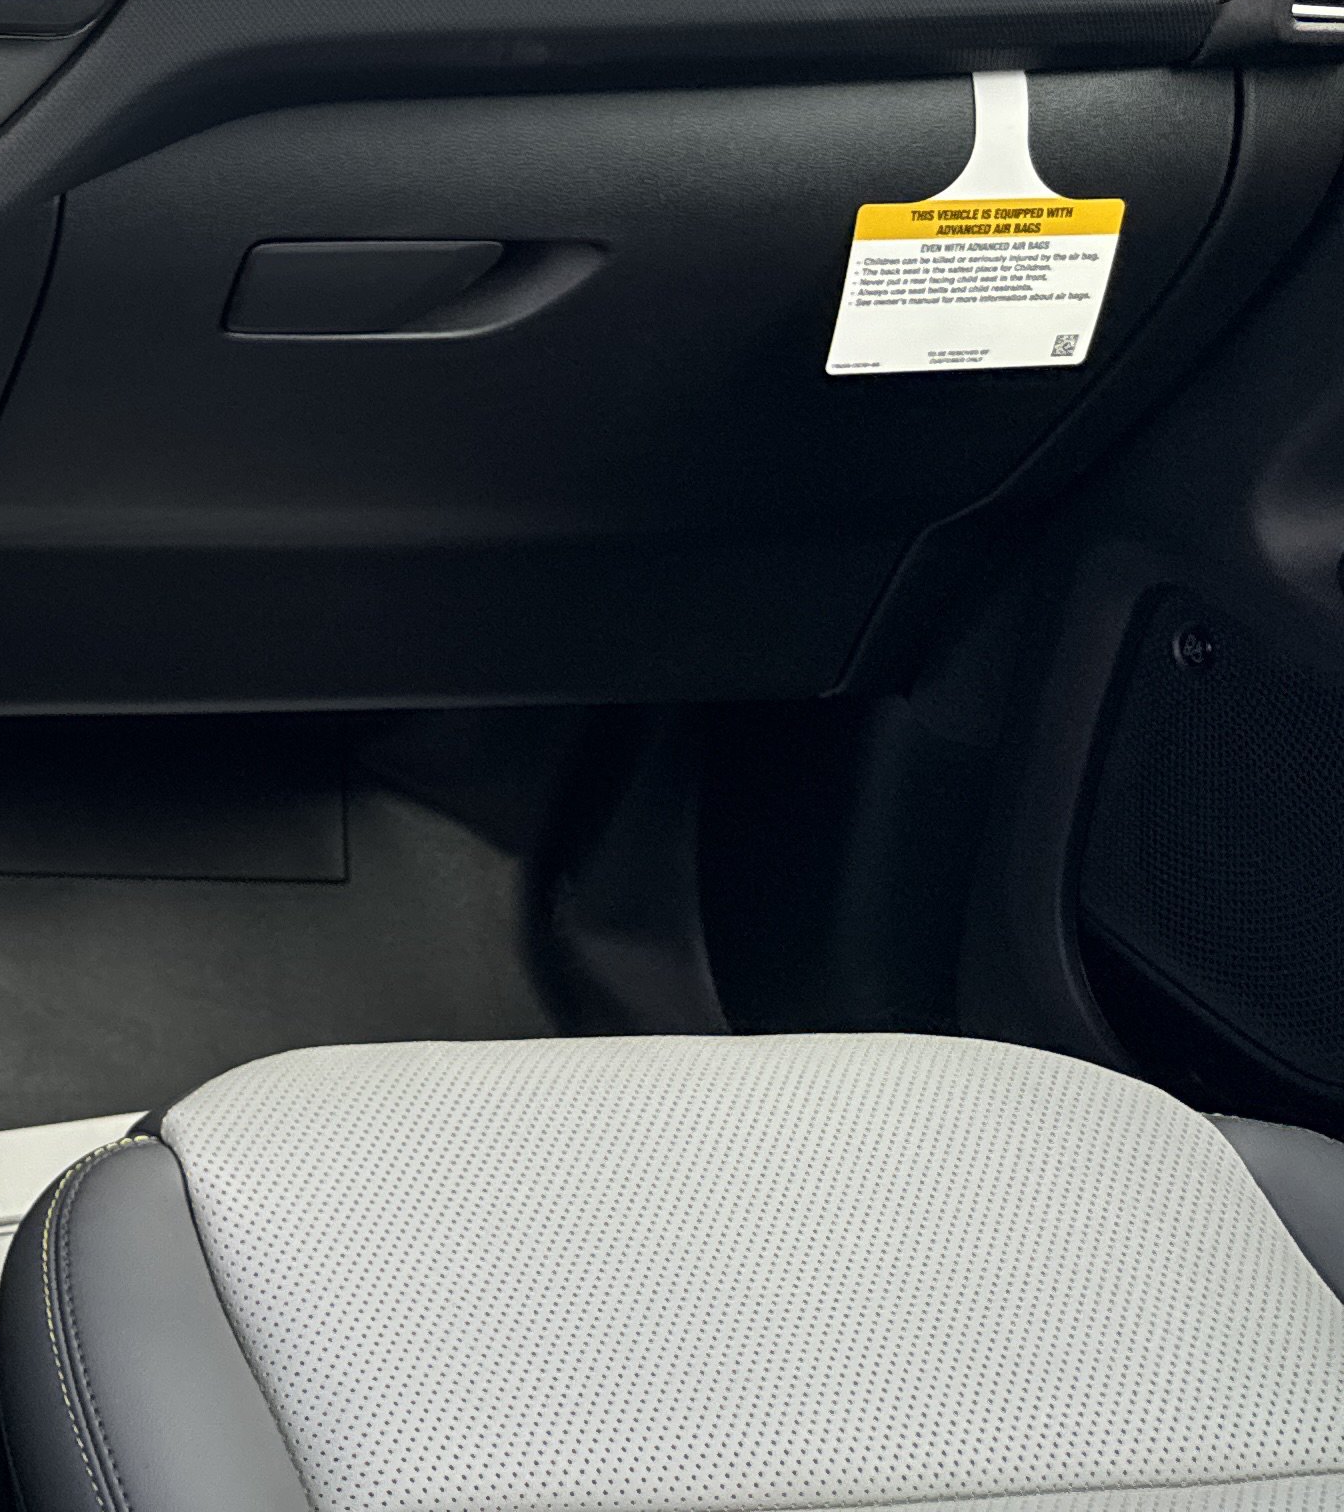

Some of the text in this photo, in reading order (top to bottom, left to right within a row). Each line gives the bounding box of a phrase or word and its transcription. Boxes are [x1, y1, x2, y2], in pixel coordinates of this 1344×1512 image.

[911, 207, 1074, 221] THIS VEHICLE IS EQUIPPED WITH
[936, 223, 1041, 236] ADVANCED AIR BAGS
[920, 241, 1050, 253] EVEN WITH ADVANCED AIR BAGS
[864, 257, 900, 266] Children
